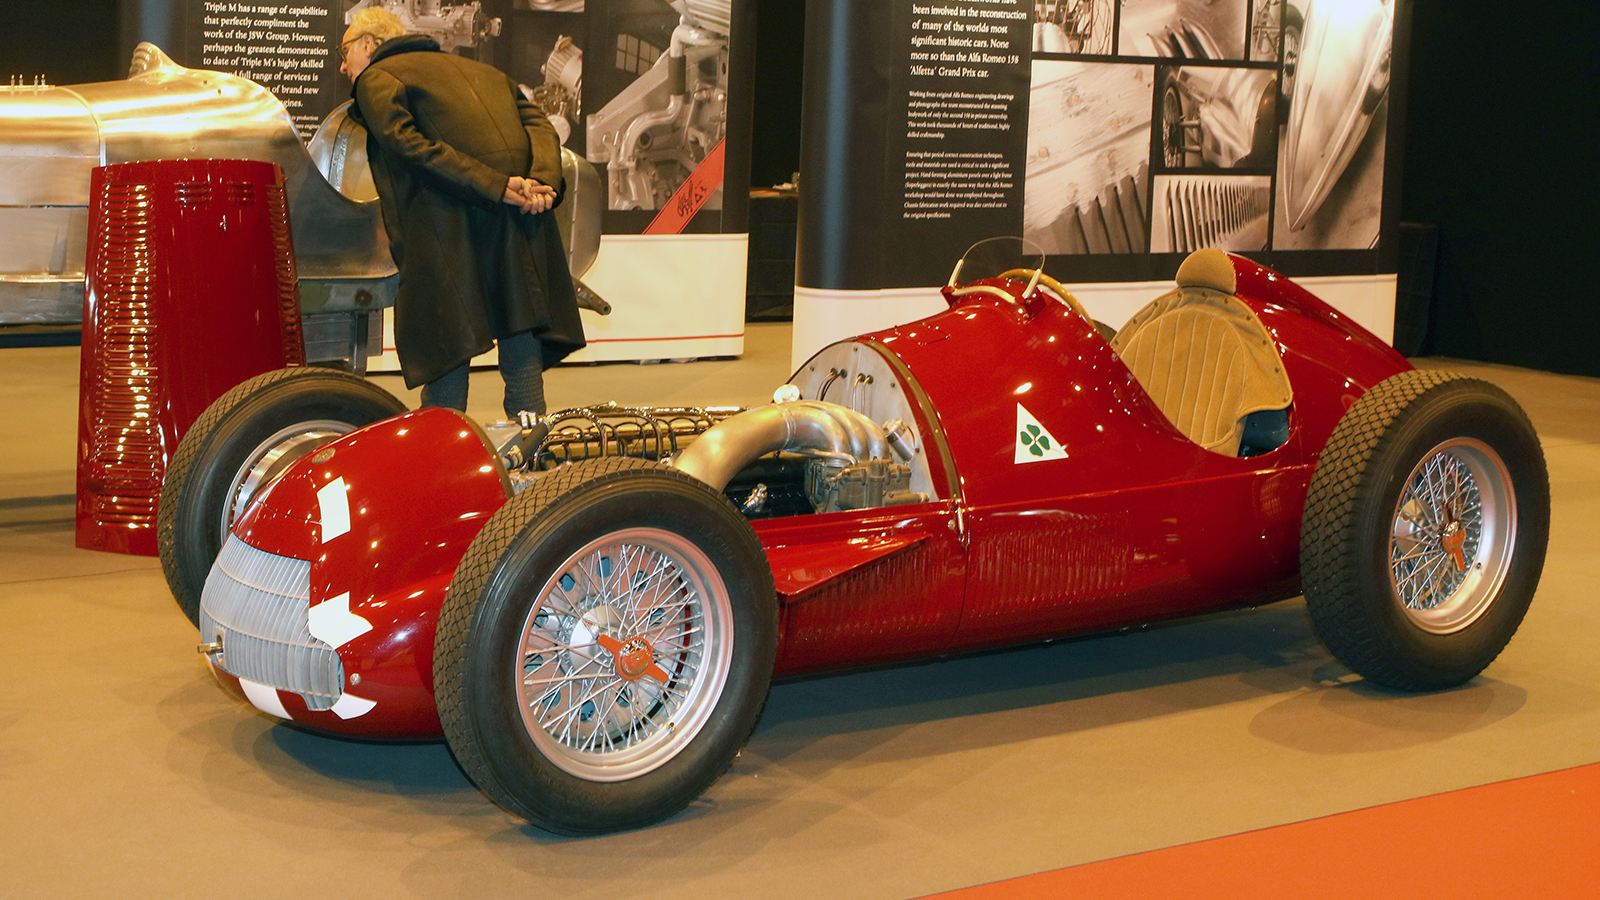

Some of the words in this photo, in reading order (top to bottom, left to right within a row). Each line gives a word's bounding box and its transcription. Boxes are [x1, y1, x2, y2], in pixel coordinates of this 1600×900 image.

[204, 2, 226, 13] Triple
[229, 3, 236, 12] M
[238, 3, 250, 12] has
[258, 6, 277, 16] range
[279, 5, 288, 14] of
[289, 6, 327, 17] capabilities
[912, 4, 929, 14] been
[931, 5, 958, 16] involved
[960, 7, 966, 16] in
[968, 7, 978, 17] the
[980, 10, 1027, 19] reconstruction
[204, 15, 219, 24] that
[220, 16, 252, 28] perfectly
[254, 18, 296, 29] compliment
[297, 19, 309, 28] the
[912, 19, 921, 29] of
[922, 23, 942, 33] many
[944, 21, 952, 31] of
[953, 21, 964, 31] the
[966, 23, 989, 33] worlds
[204, 29, 223, 38] work
[225, 30, 234, 38] of
[235, 30, 247, 39] the
[247, 31, 264, 41] JSW
[266, 32, 290, 43] Group.
[292, 33, 325, 43] However,
[911, 35, 946, 47] significant
[948, 36, 972, 47] historic
[990, 39, 1009, 48] None
[203, 43, 233, 54] perhaps
[234, 43, 245, 52] the
[247, 46, 275, 55] greatest
[277, 45, 328, 55] demonstration
[213, 56, 229, 65] date
[231, 57, 240, 65] of
[241, 57, 262, 68] Triple
[264, 58, 276, 67] M's
[278, 58, 299, 70] highly
[300, 59, 324, 68] skilled
[940, 51, 955, 61] than
[956, 52, 966, 62] the
[968, 52, 981, 62] Alfa
[982, 53, 1006, 63] Romeo
[1007, 55, 1019, 64] 158
[253, 73, 272, 82] range
[274, 71, 283, 80] of
[284, 73, 311, 81] services
[312, 73, 318, 81] is
[938, 67, 960, 76] Grand
[962, 68, 976, 77] Prix
[272, 85, 280, 94] of
[282, 85, 302, 94] brand
